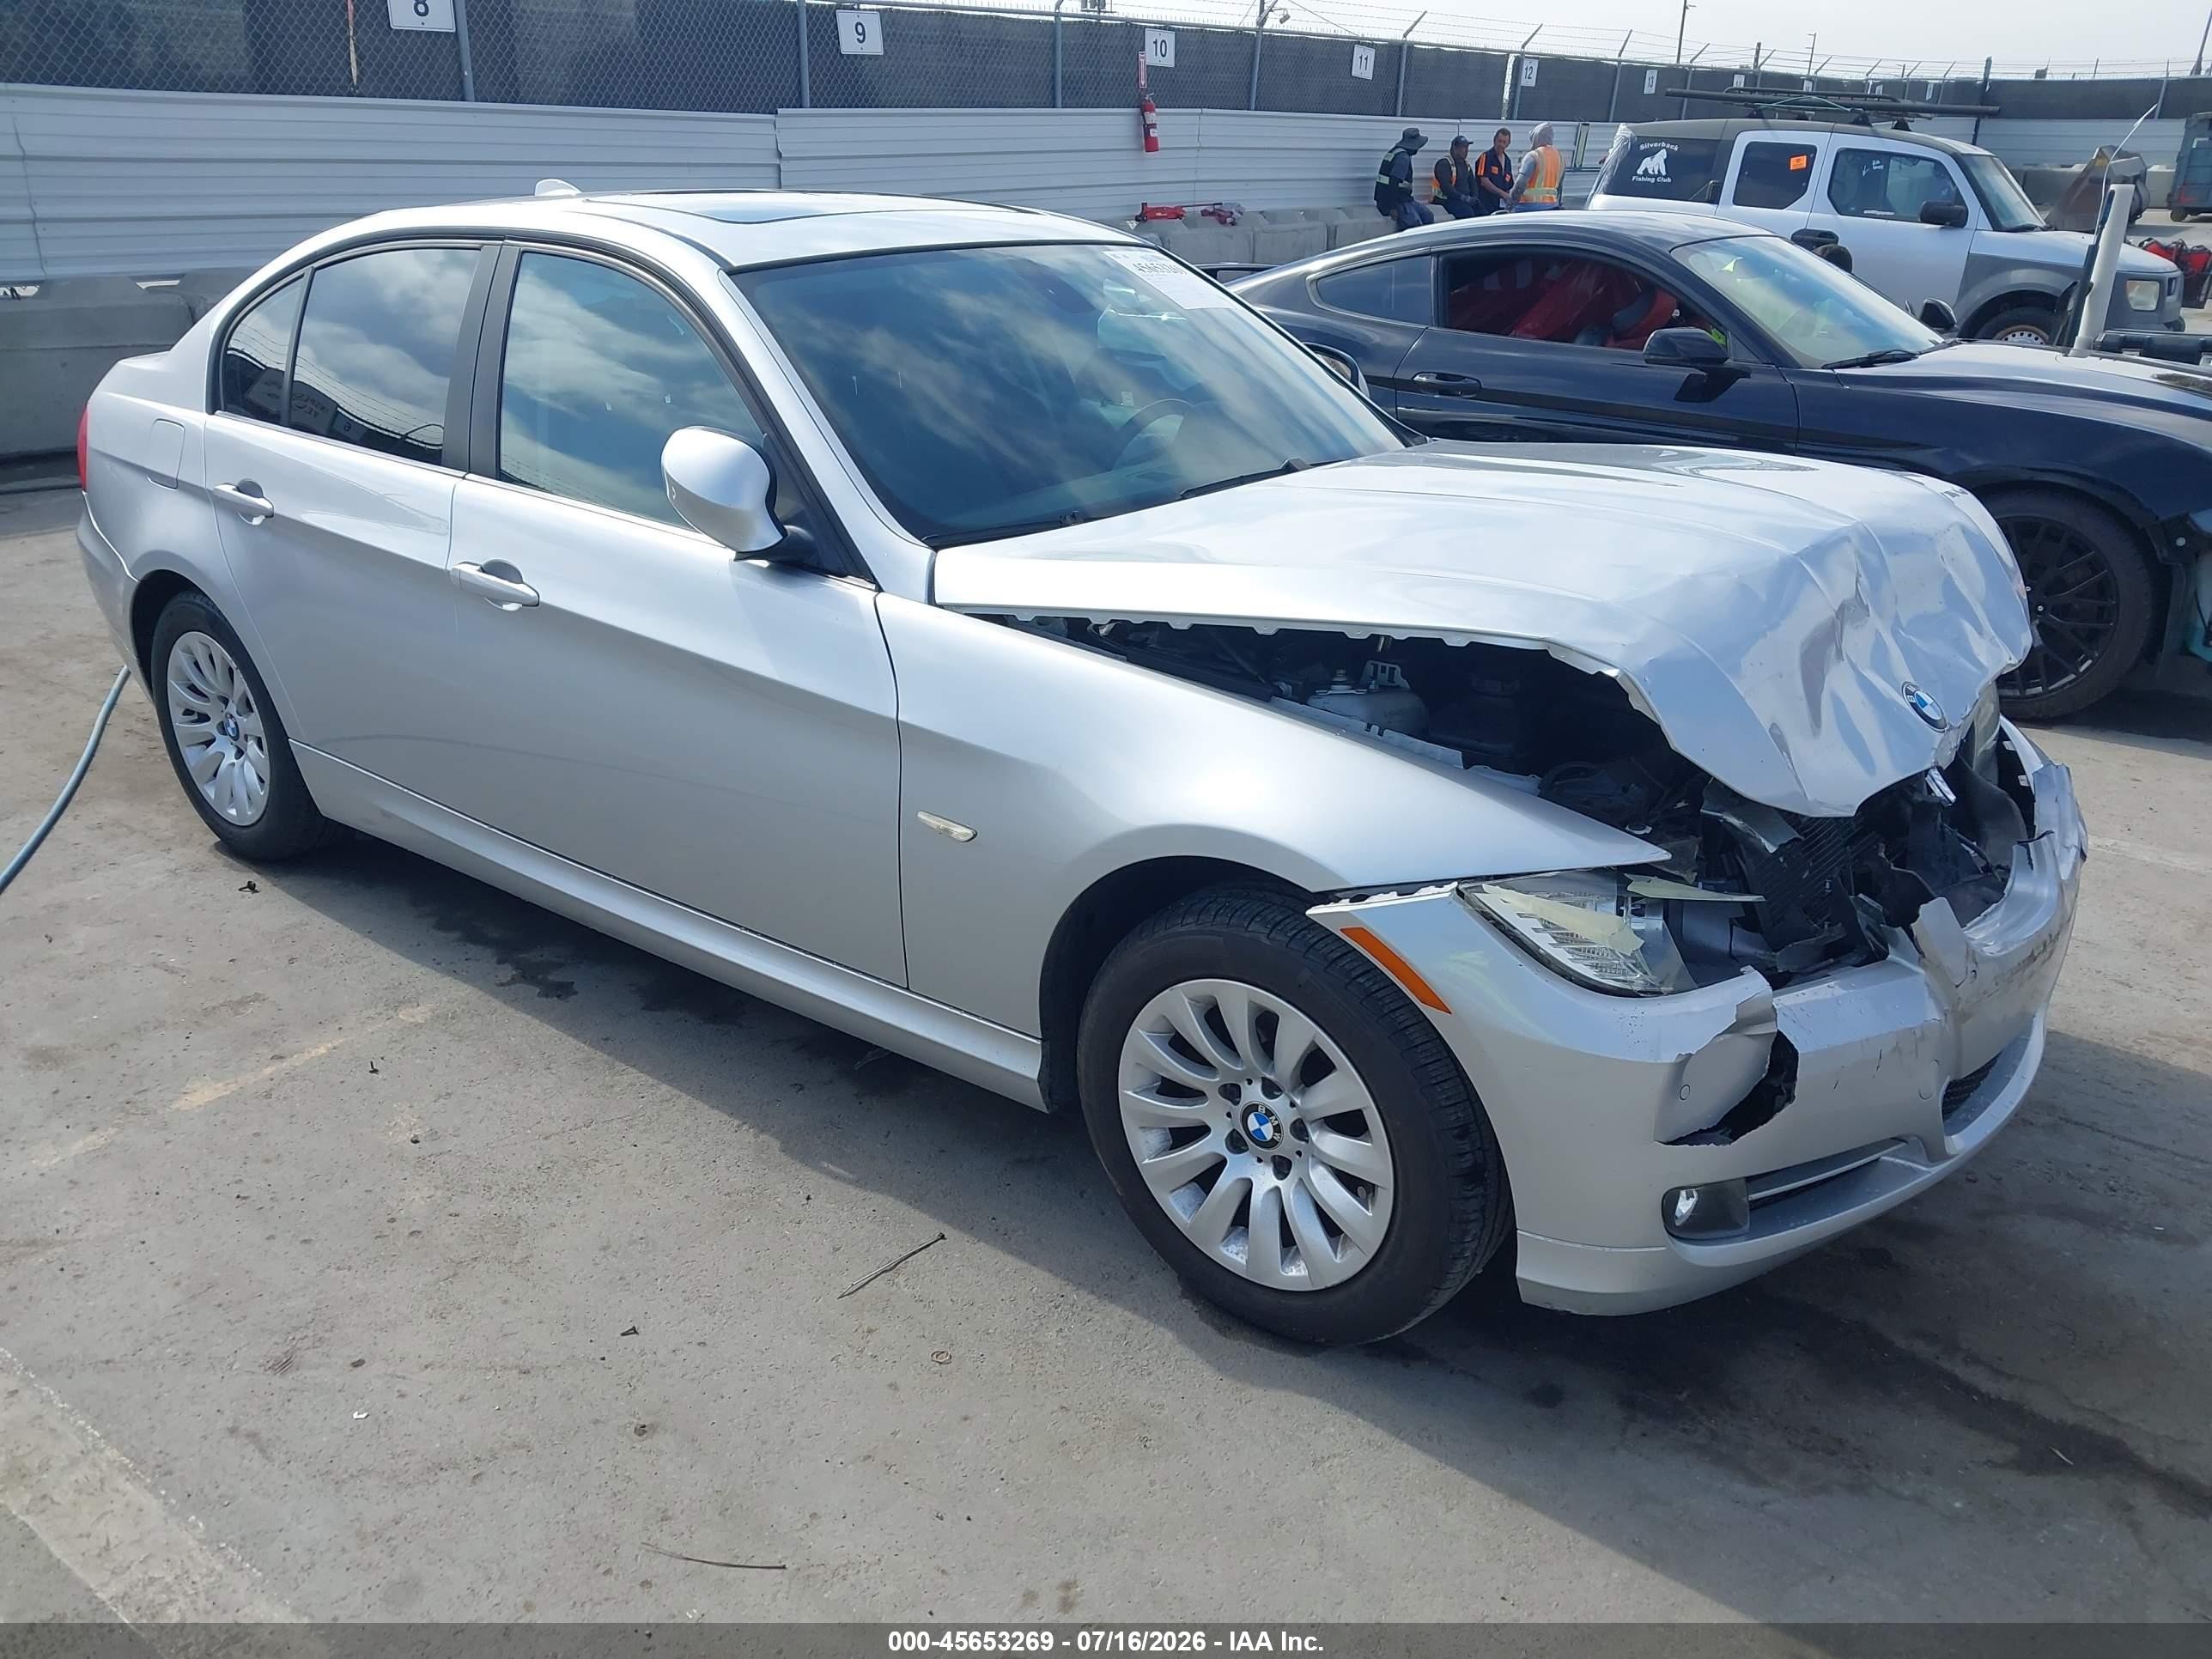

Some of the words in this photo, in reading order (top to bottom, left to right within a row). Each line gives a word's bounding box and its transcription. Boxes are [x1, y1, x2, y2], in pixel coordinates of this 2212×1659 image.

[854, 21, 866, 44] 9
[1152, 38, 1168, 58] 10
[1358, 54, 1369, 71] 11
[1524, 65, 1534, 80] 12
[1639, 141, 1680, 151] Silverback
